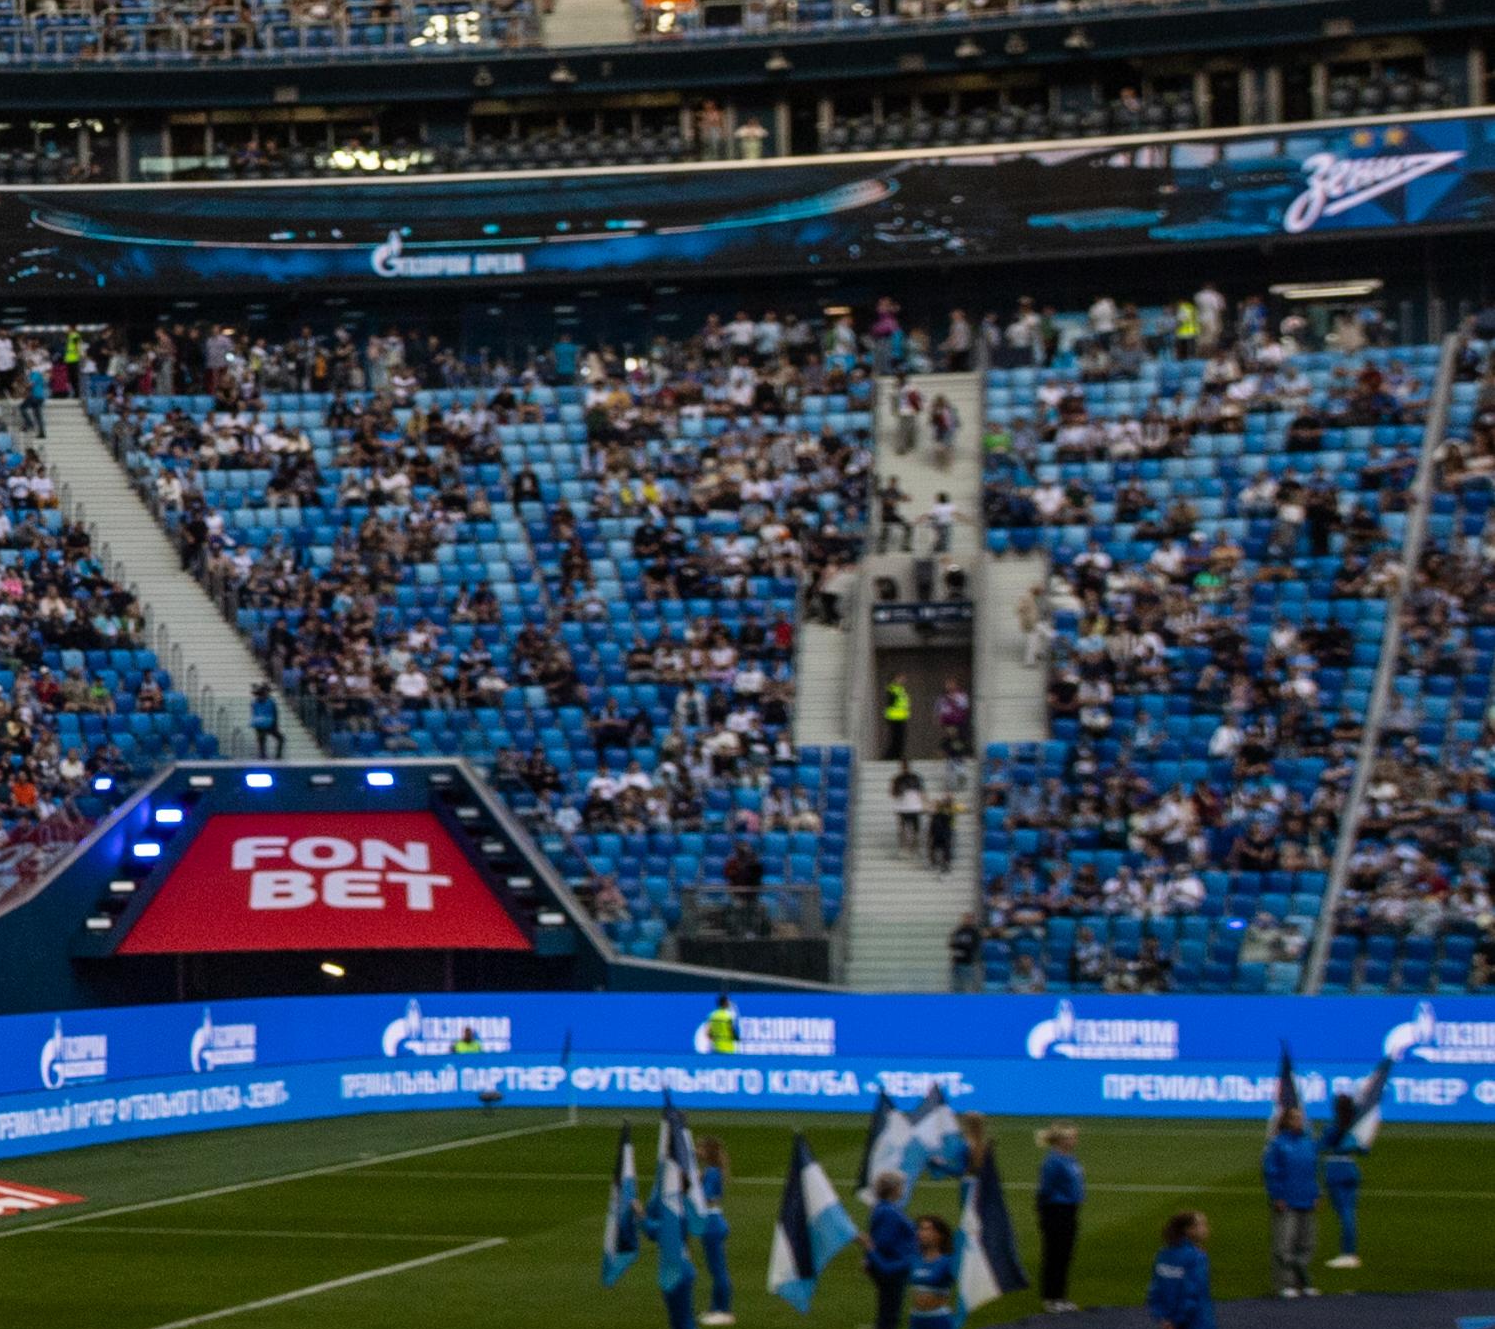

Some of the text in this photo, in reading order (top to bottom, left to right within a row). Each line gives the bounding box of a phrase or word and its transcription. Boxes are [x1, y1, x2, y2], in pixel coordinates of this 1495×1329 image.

[230, 836, 431, 871] FON
[249, 871, 452, 910] BET
[768, 1070, 859, 1096] КЛУБА
